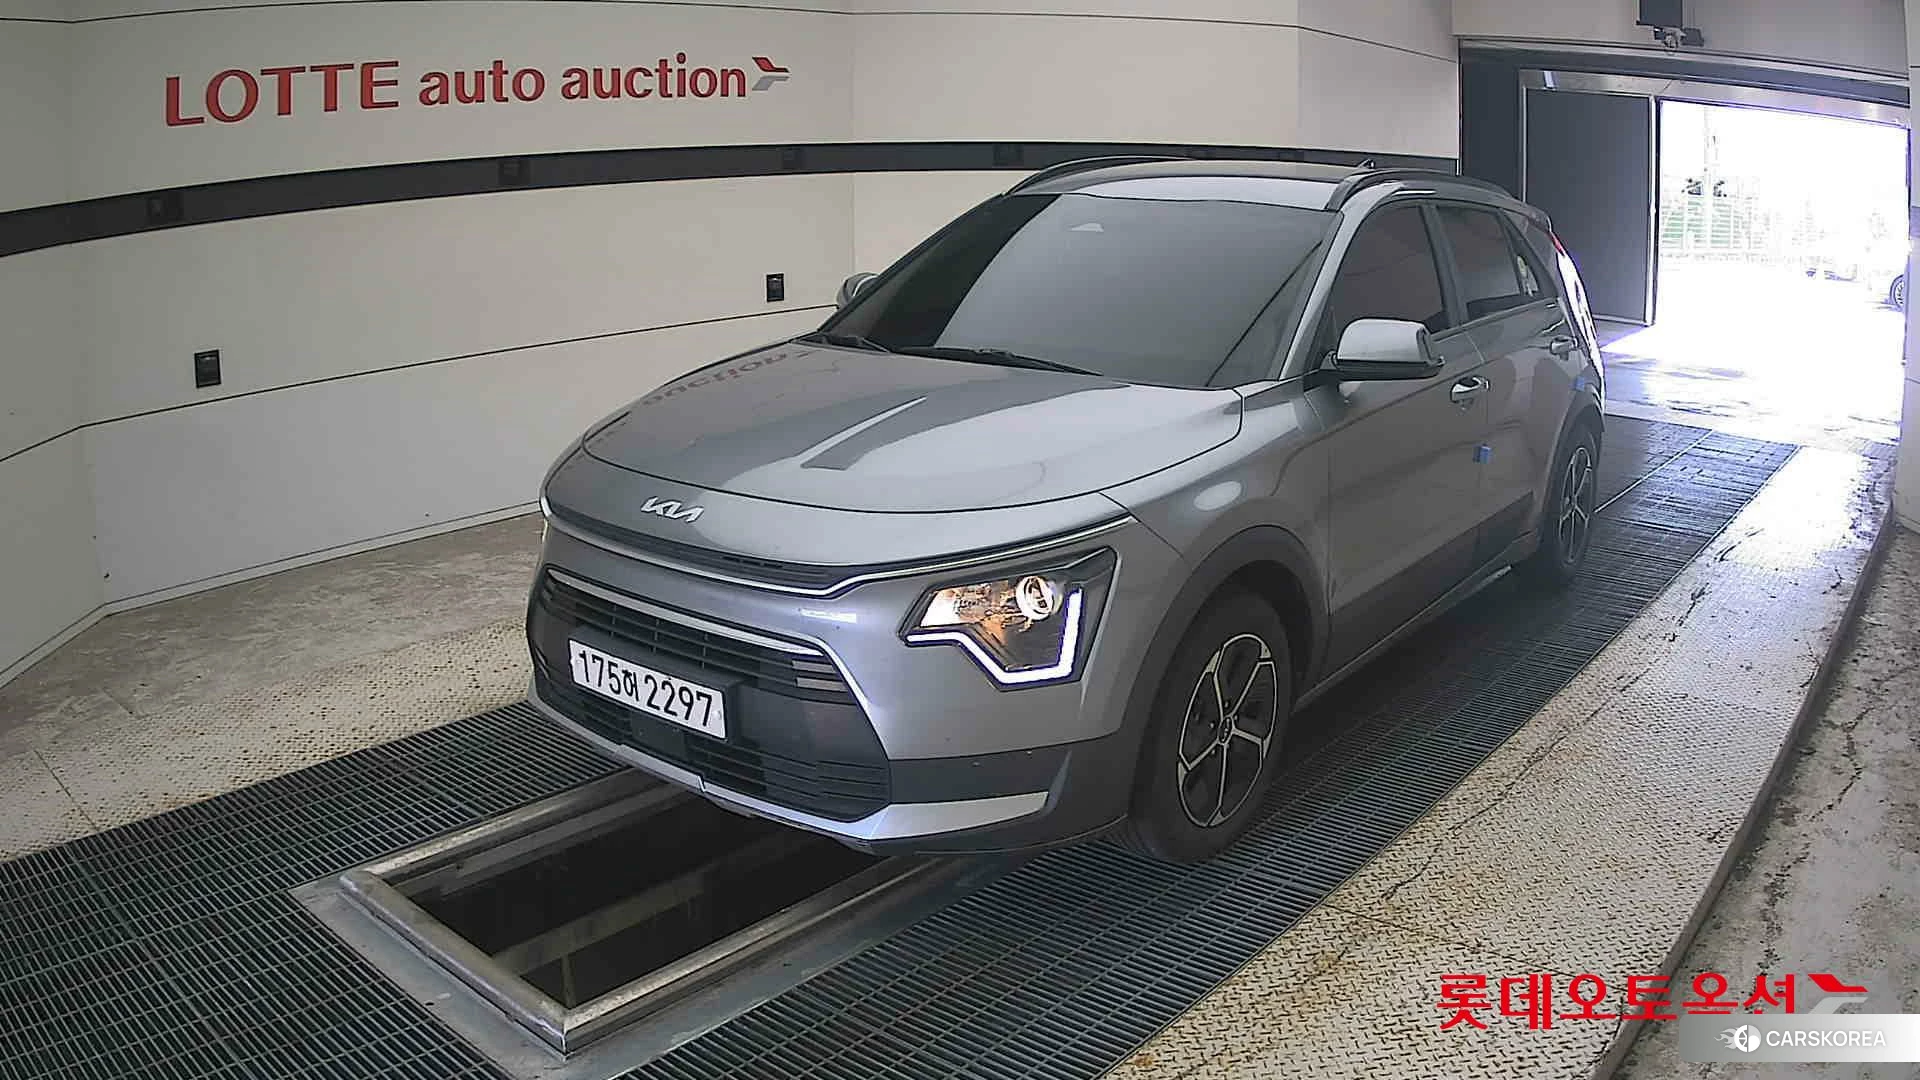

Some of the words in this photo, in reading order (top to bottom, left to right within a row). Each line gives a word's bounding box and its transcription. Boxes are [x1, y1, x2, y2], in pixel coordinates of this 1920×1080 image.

[165, 60, 399, 126] LOTTE
[418, 60, 545, 105] auto
[560, 52, 747, 100] auction
[640, 496, 705, 523] KIA
